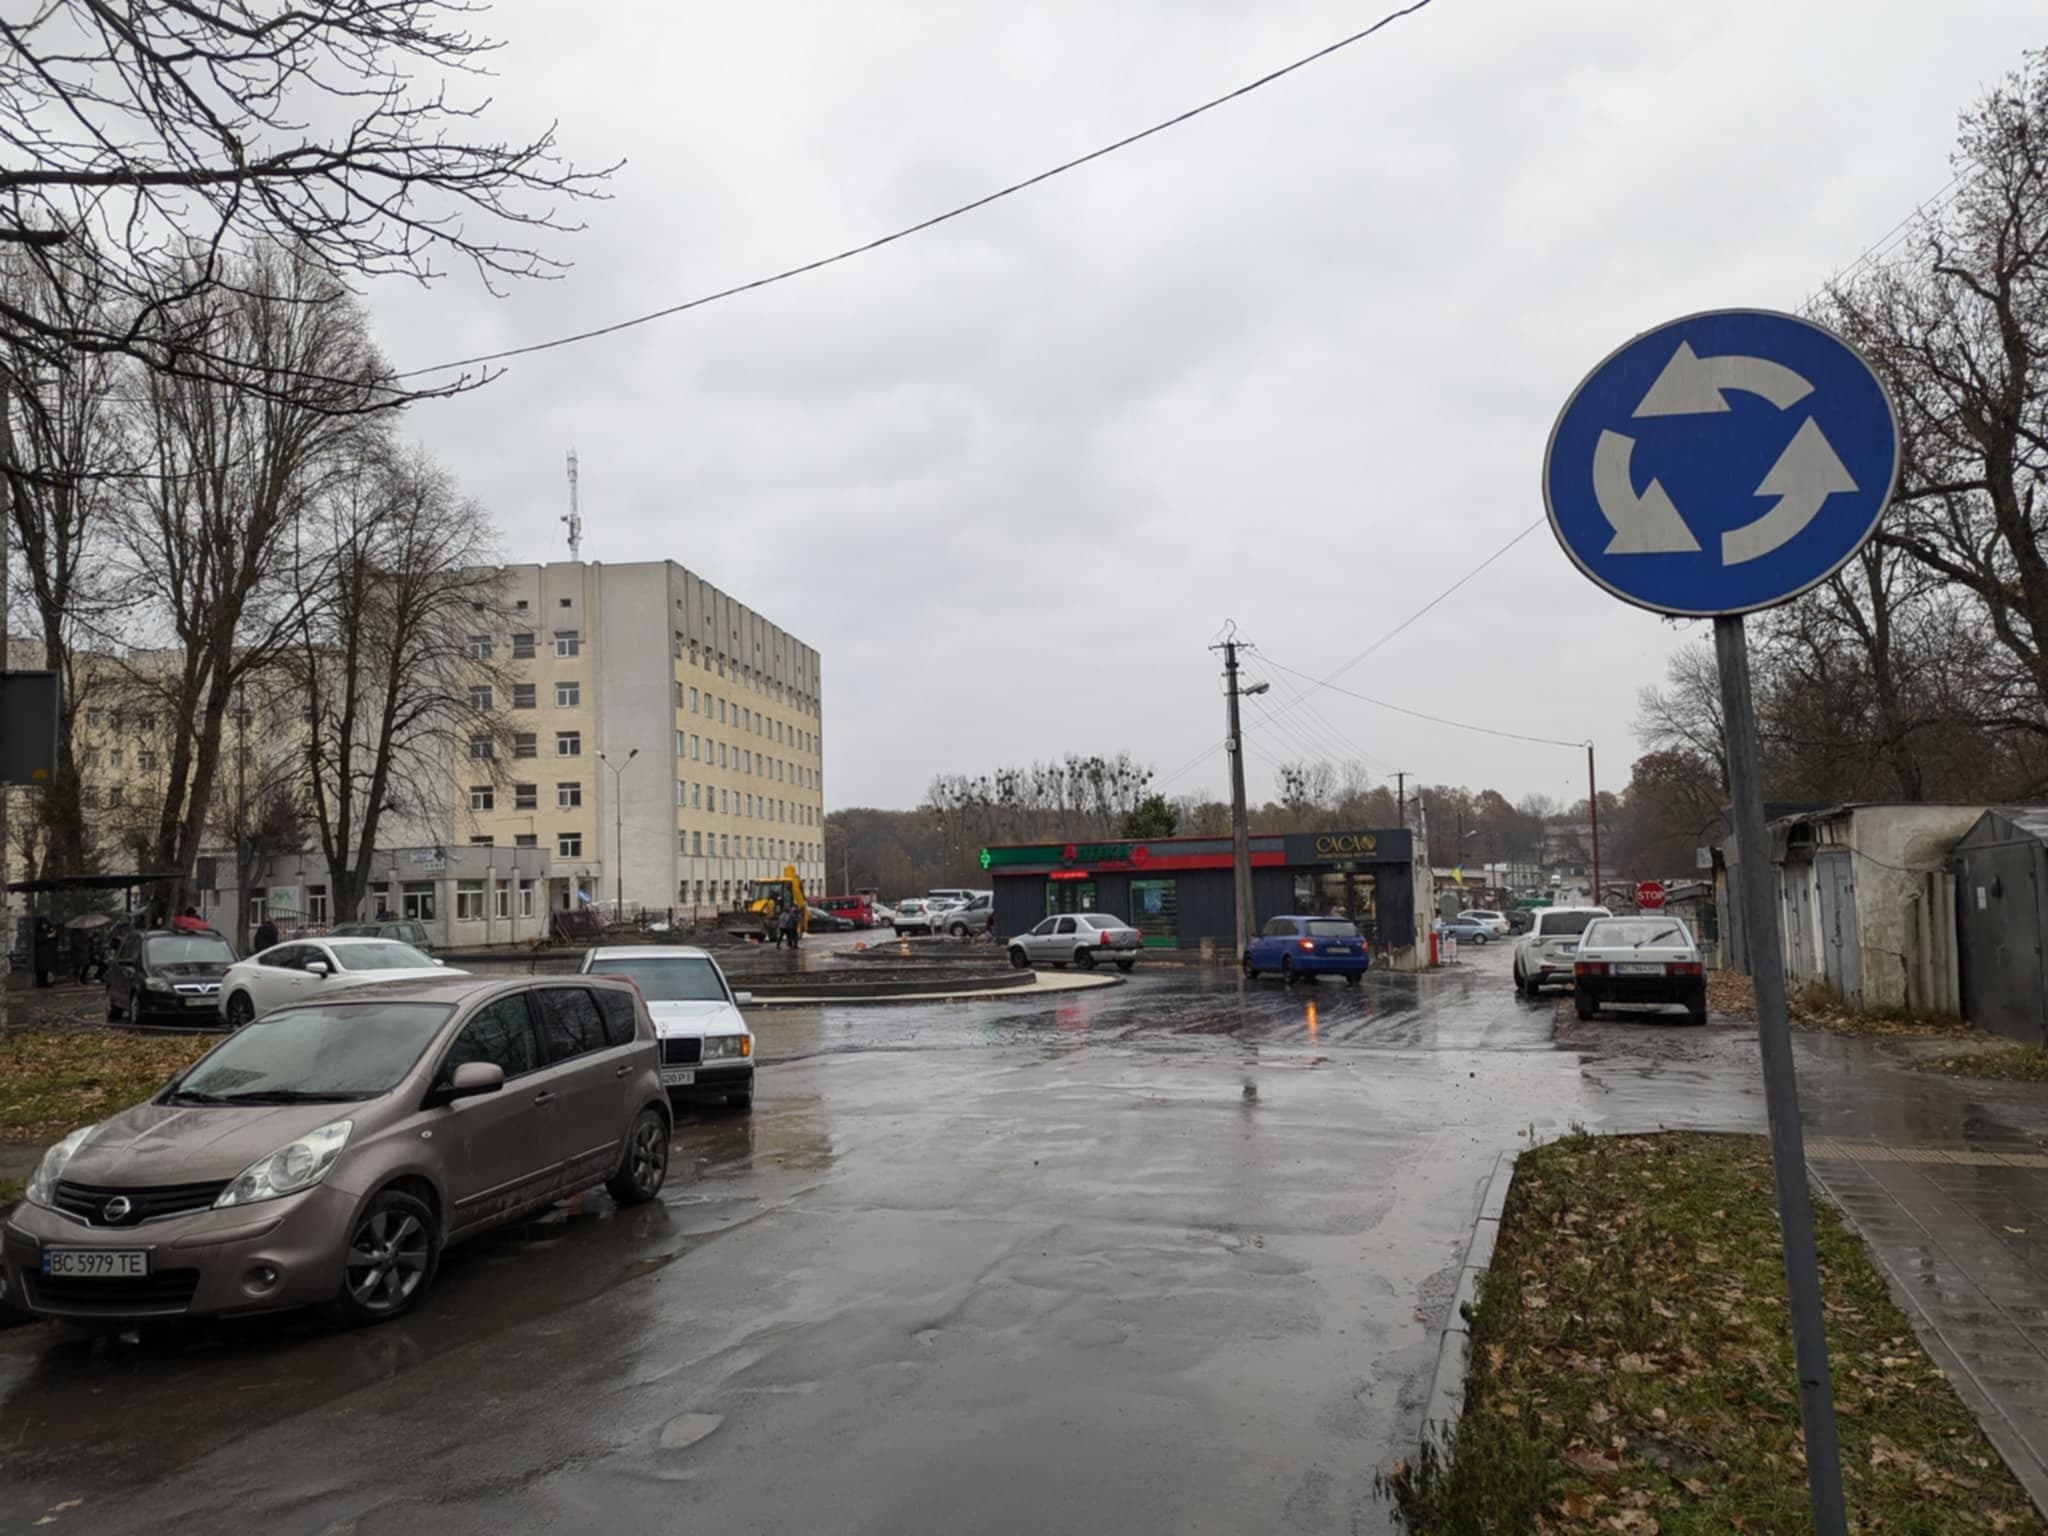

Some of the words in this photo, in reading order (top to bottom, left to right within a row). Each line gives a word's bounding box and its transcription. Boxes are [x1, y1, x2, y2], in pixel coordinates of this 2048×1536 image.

[1637, 890, 1664, 900] STOP
[52, 1254, 74, 1273] BC
[77, 1255, 114, 1273] 5979
[118, 1254, 143, 1273] TE
